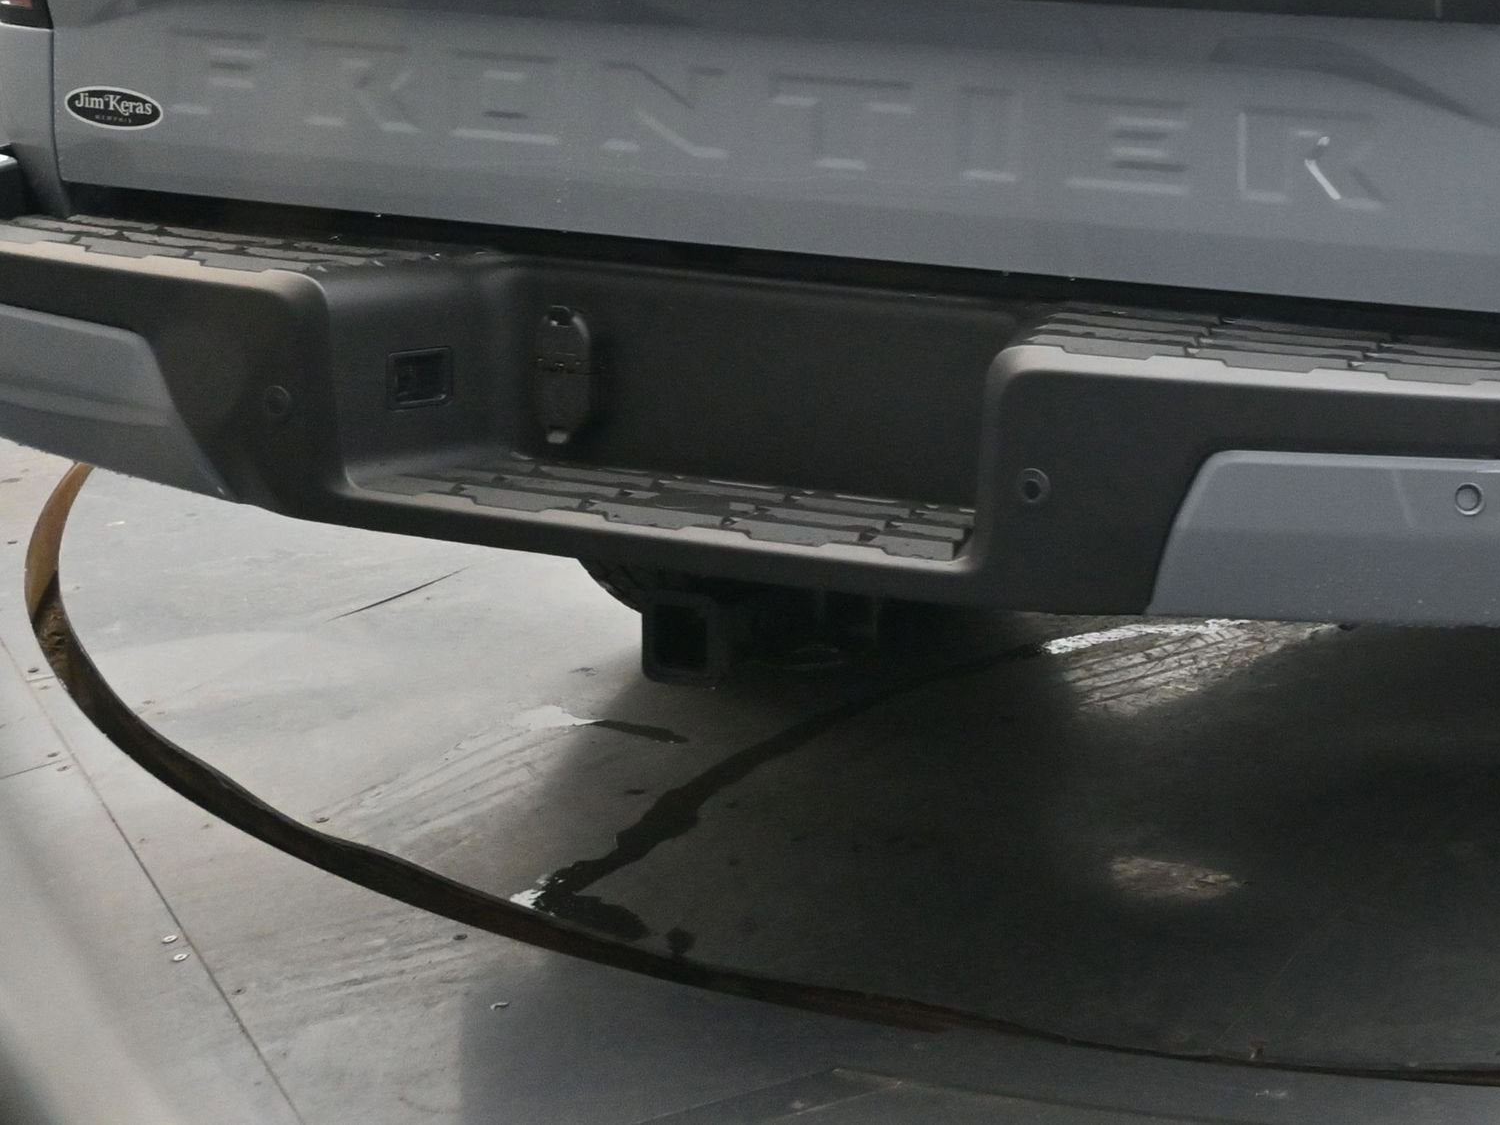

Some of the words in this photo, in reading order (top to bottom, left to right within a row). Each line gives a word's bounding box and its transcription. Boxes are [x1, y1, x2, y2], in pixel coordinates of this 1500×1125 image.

[75, 92, 104, 110] Jim
[104, 94, 153, 116] Keras
[168, 27, 1385, 210] FRONTIER
